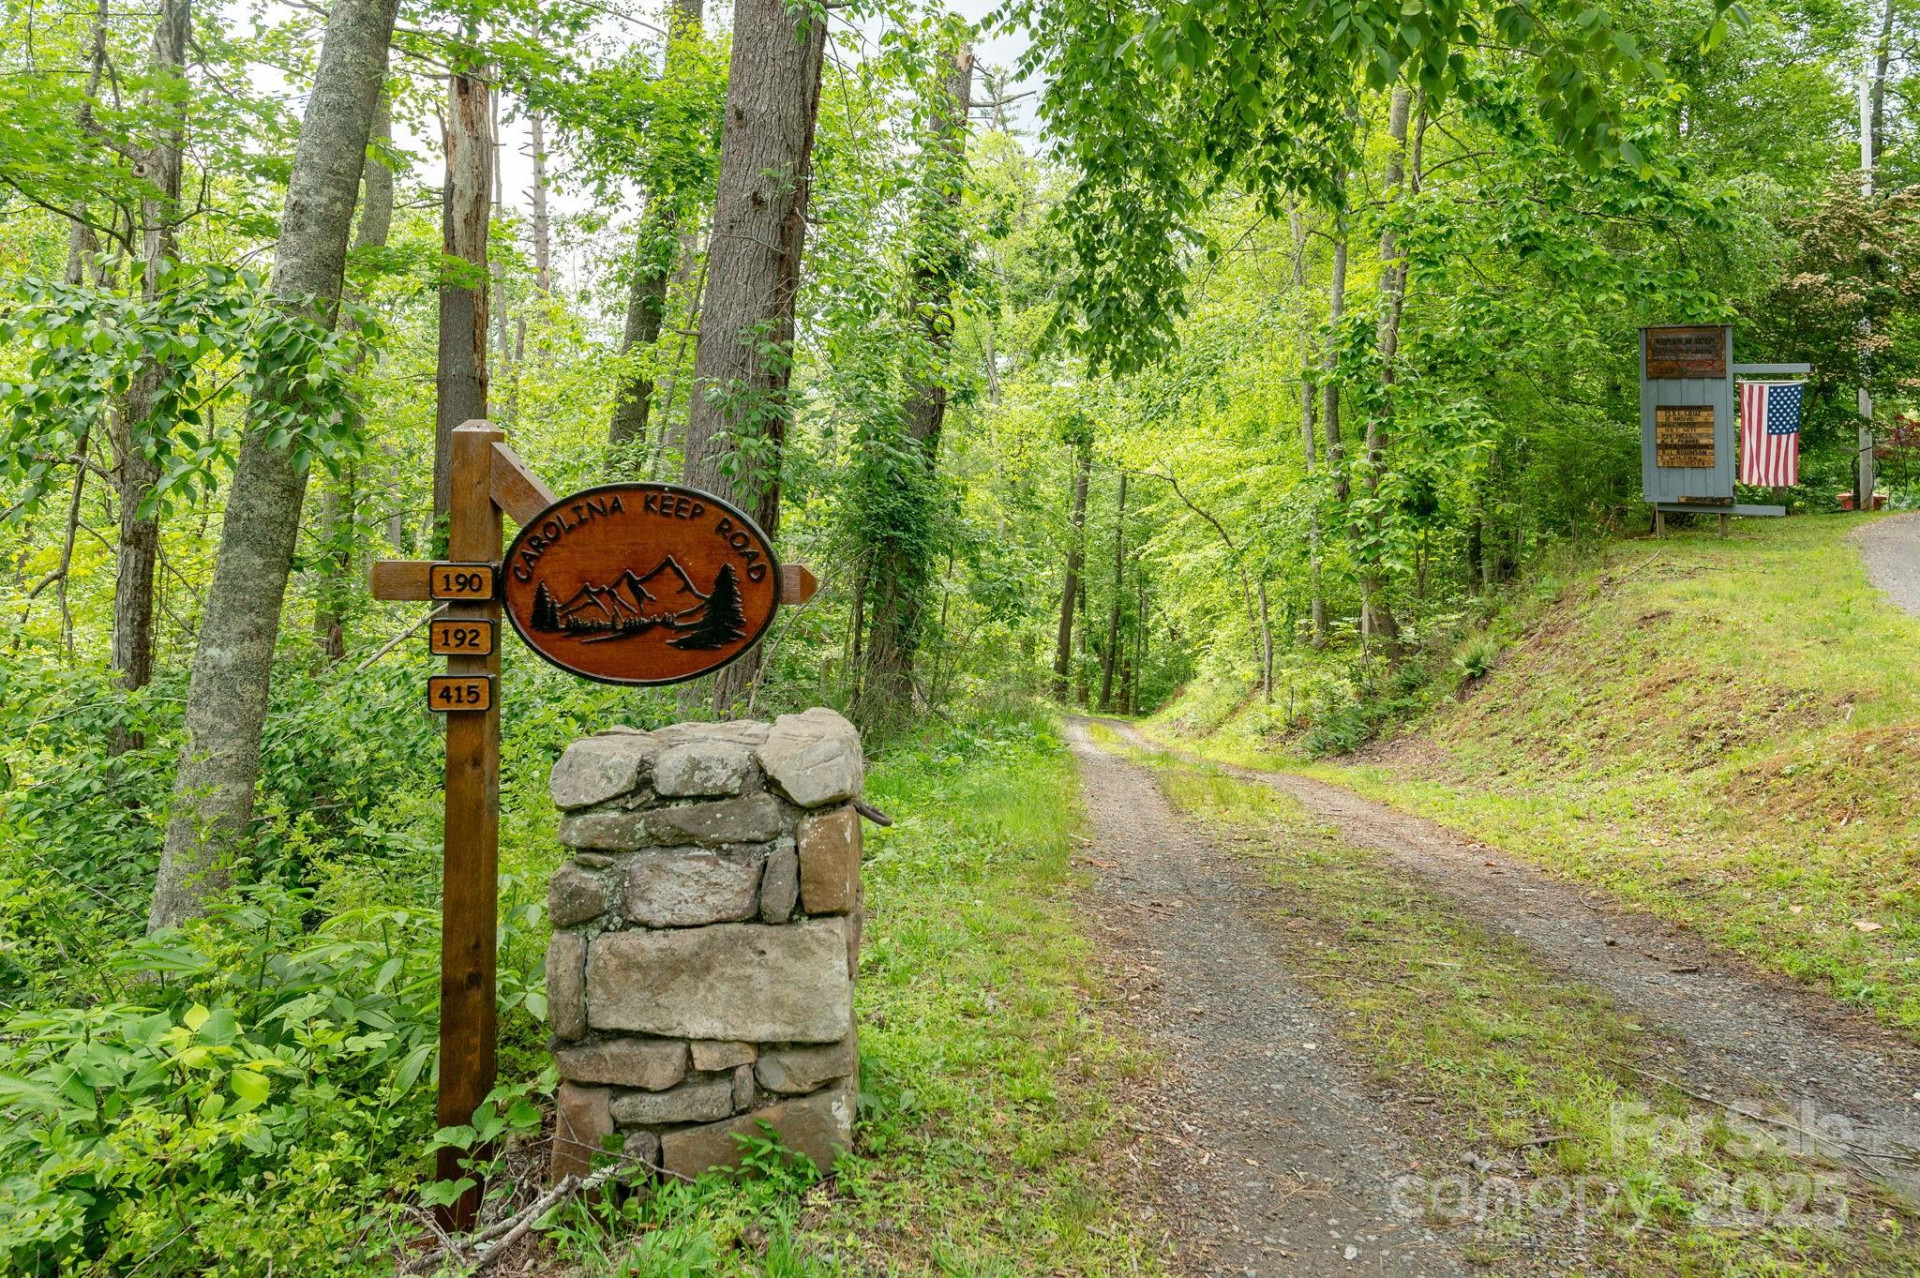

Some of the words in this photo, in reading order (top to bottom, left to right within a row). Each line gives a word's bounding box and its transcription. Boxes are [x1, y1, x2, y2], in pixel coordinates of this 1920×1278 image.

[513, 494, 625, 584] CAROLINA
[642, 493, 706, 521] KEEP
[715, 516, 767, 582] ROAD
[443, 573, 483, 593] 190
[441, 628, 480, 648] 192
[438, 684, 480, 704] 415
